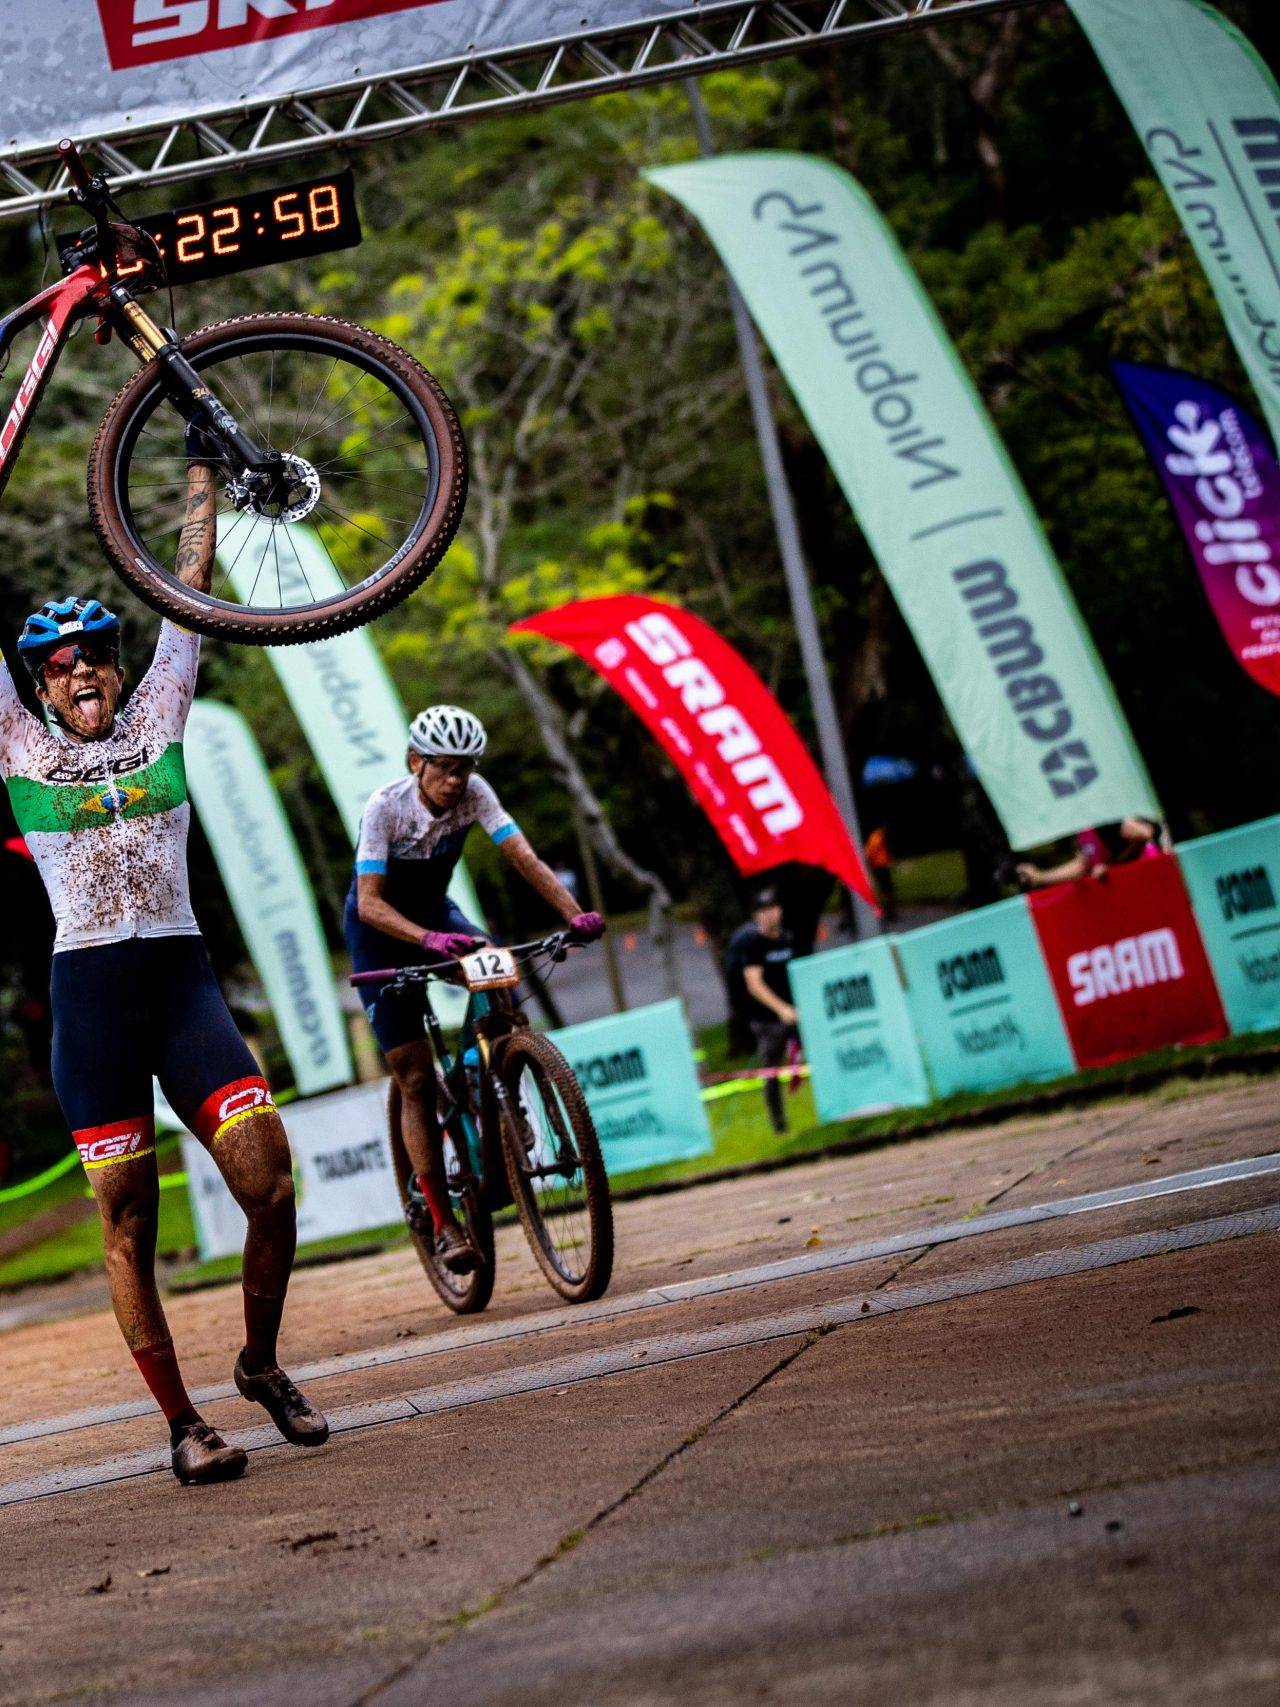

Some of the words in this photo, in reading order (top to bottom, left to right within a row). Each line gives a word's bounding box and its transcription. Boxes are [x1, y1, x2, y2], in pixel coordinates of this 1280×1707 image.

[624, 611, 805, 837] SRAM
[473, 953, 505, 977] 12
[1067, 926, 1186, 1007] SRAM
